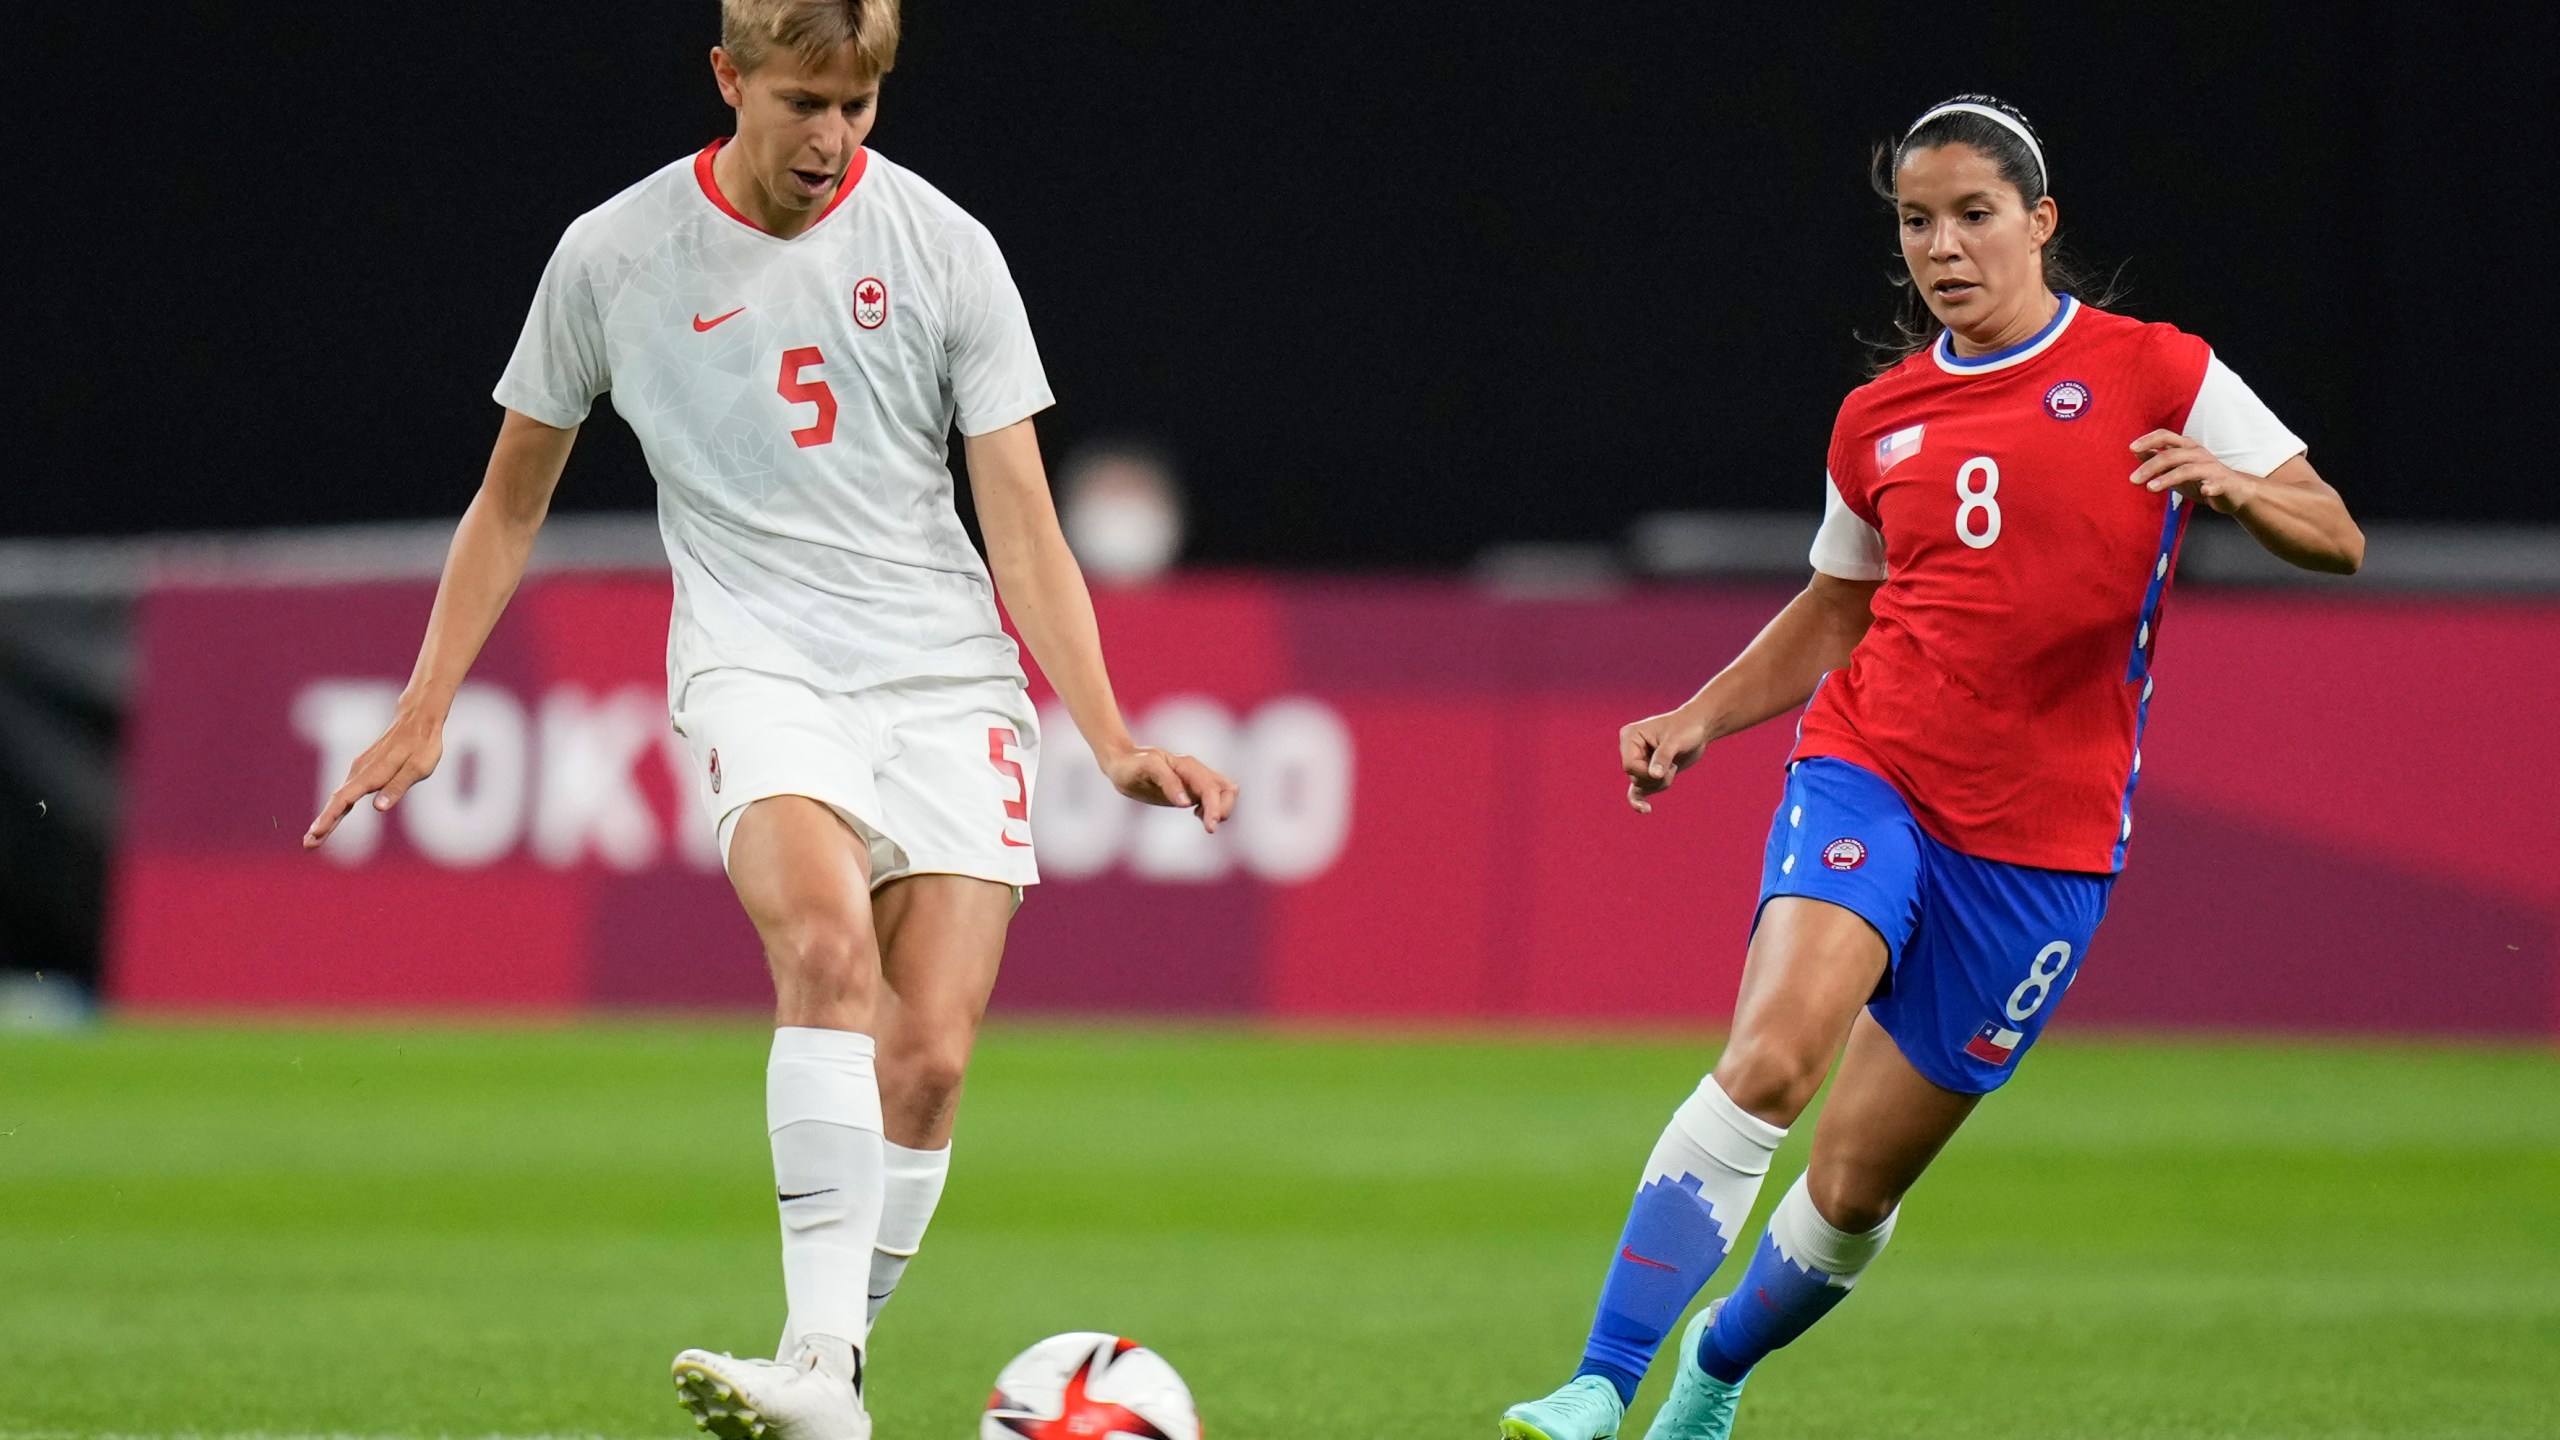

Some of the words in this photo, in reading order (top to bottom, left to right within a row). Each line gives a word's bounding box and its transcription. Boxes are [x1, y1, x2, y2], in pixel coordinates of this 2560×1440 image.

[777, 346, 837, 448] 5
[1955, 456, 2001, 549] 8
[292, 680, 724, 872] TOK
[988, 727, 1027, 821] 5
[2006, 940, 2071, 1021] 8
